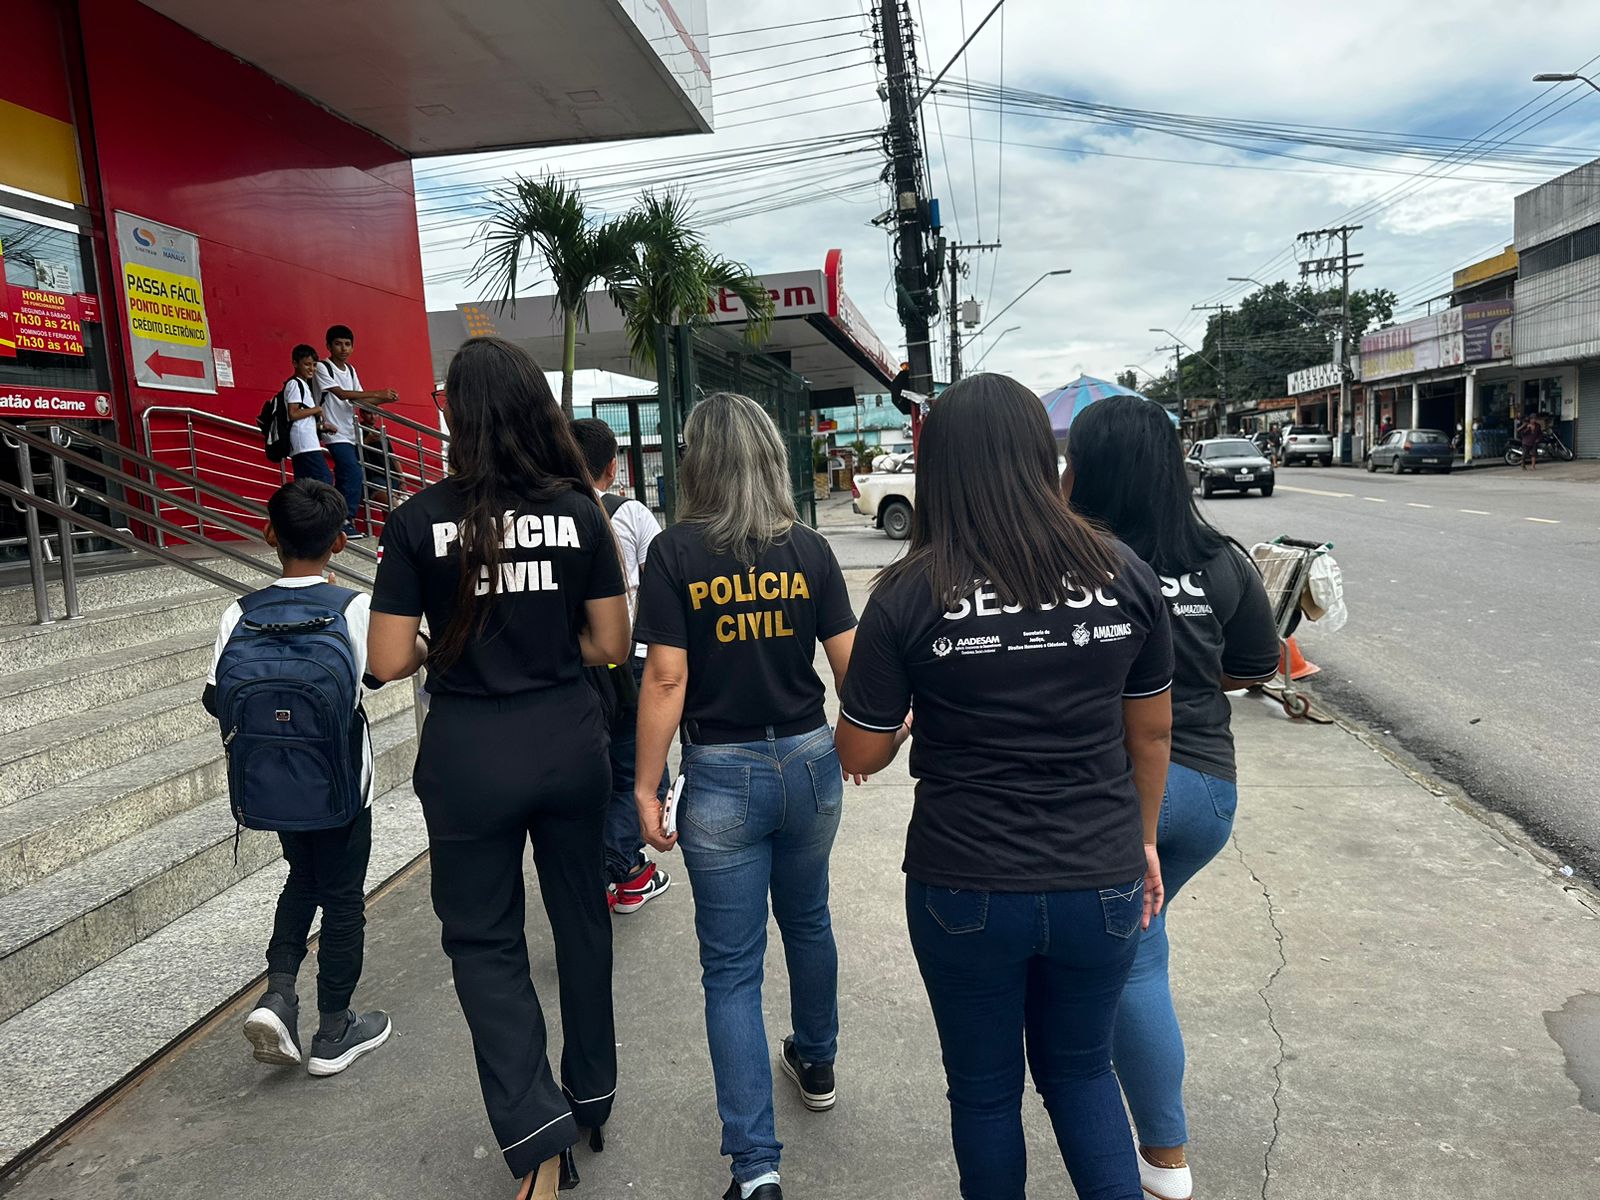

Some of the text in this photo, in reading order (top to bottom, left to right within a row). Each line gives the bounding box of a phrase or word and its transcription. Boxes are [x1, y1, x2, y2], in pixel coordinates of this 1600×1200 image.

[163, 251, 186, 263] MANAUS
[22, 290, 65, 305] HORÁRIO
[127, 274, 200, 305] PASSA FÁCIL
[21, 306, 46, 316] SEGUNDA
[51, 311, 71, 319] SÁBADO
[130, 298, 203, 323] PONTO DE VENDA
[13, 312, 80, 331] 7h30 às 21h
[133, 317, 205, 340] CRÉDITO ELETRÔNICO
[20, 327, 48, 337] DOMINGOS
[53, 332, 77, 341] FERIADOS
[16, 335, 84, 352] 7h30 às 14h
[1291, 373, 1339, 393] MICROOND
[34, 397, 50, 409] da
[51, 397, 86, 411] Carne
[688, 566, 810, 610] POLÍCIA
[1179, 604, 1213, 614] AMAZONAS
[716, 610, 794, 643] CIVIL
[1093, 623, 1132, 640] AMAZONAS
[957, 636, 1000, 646] AADESAM
